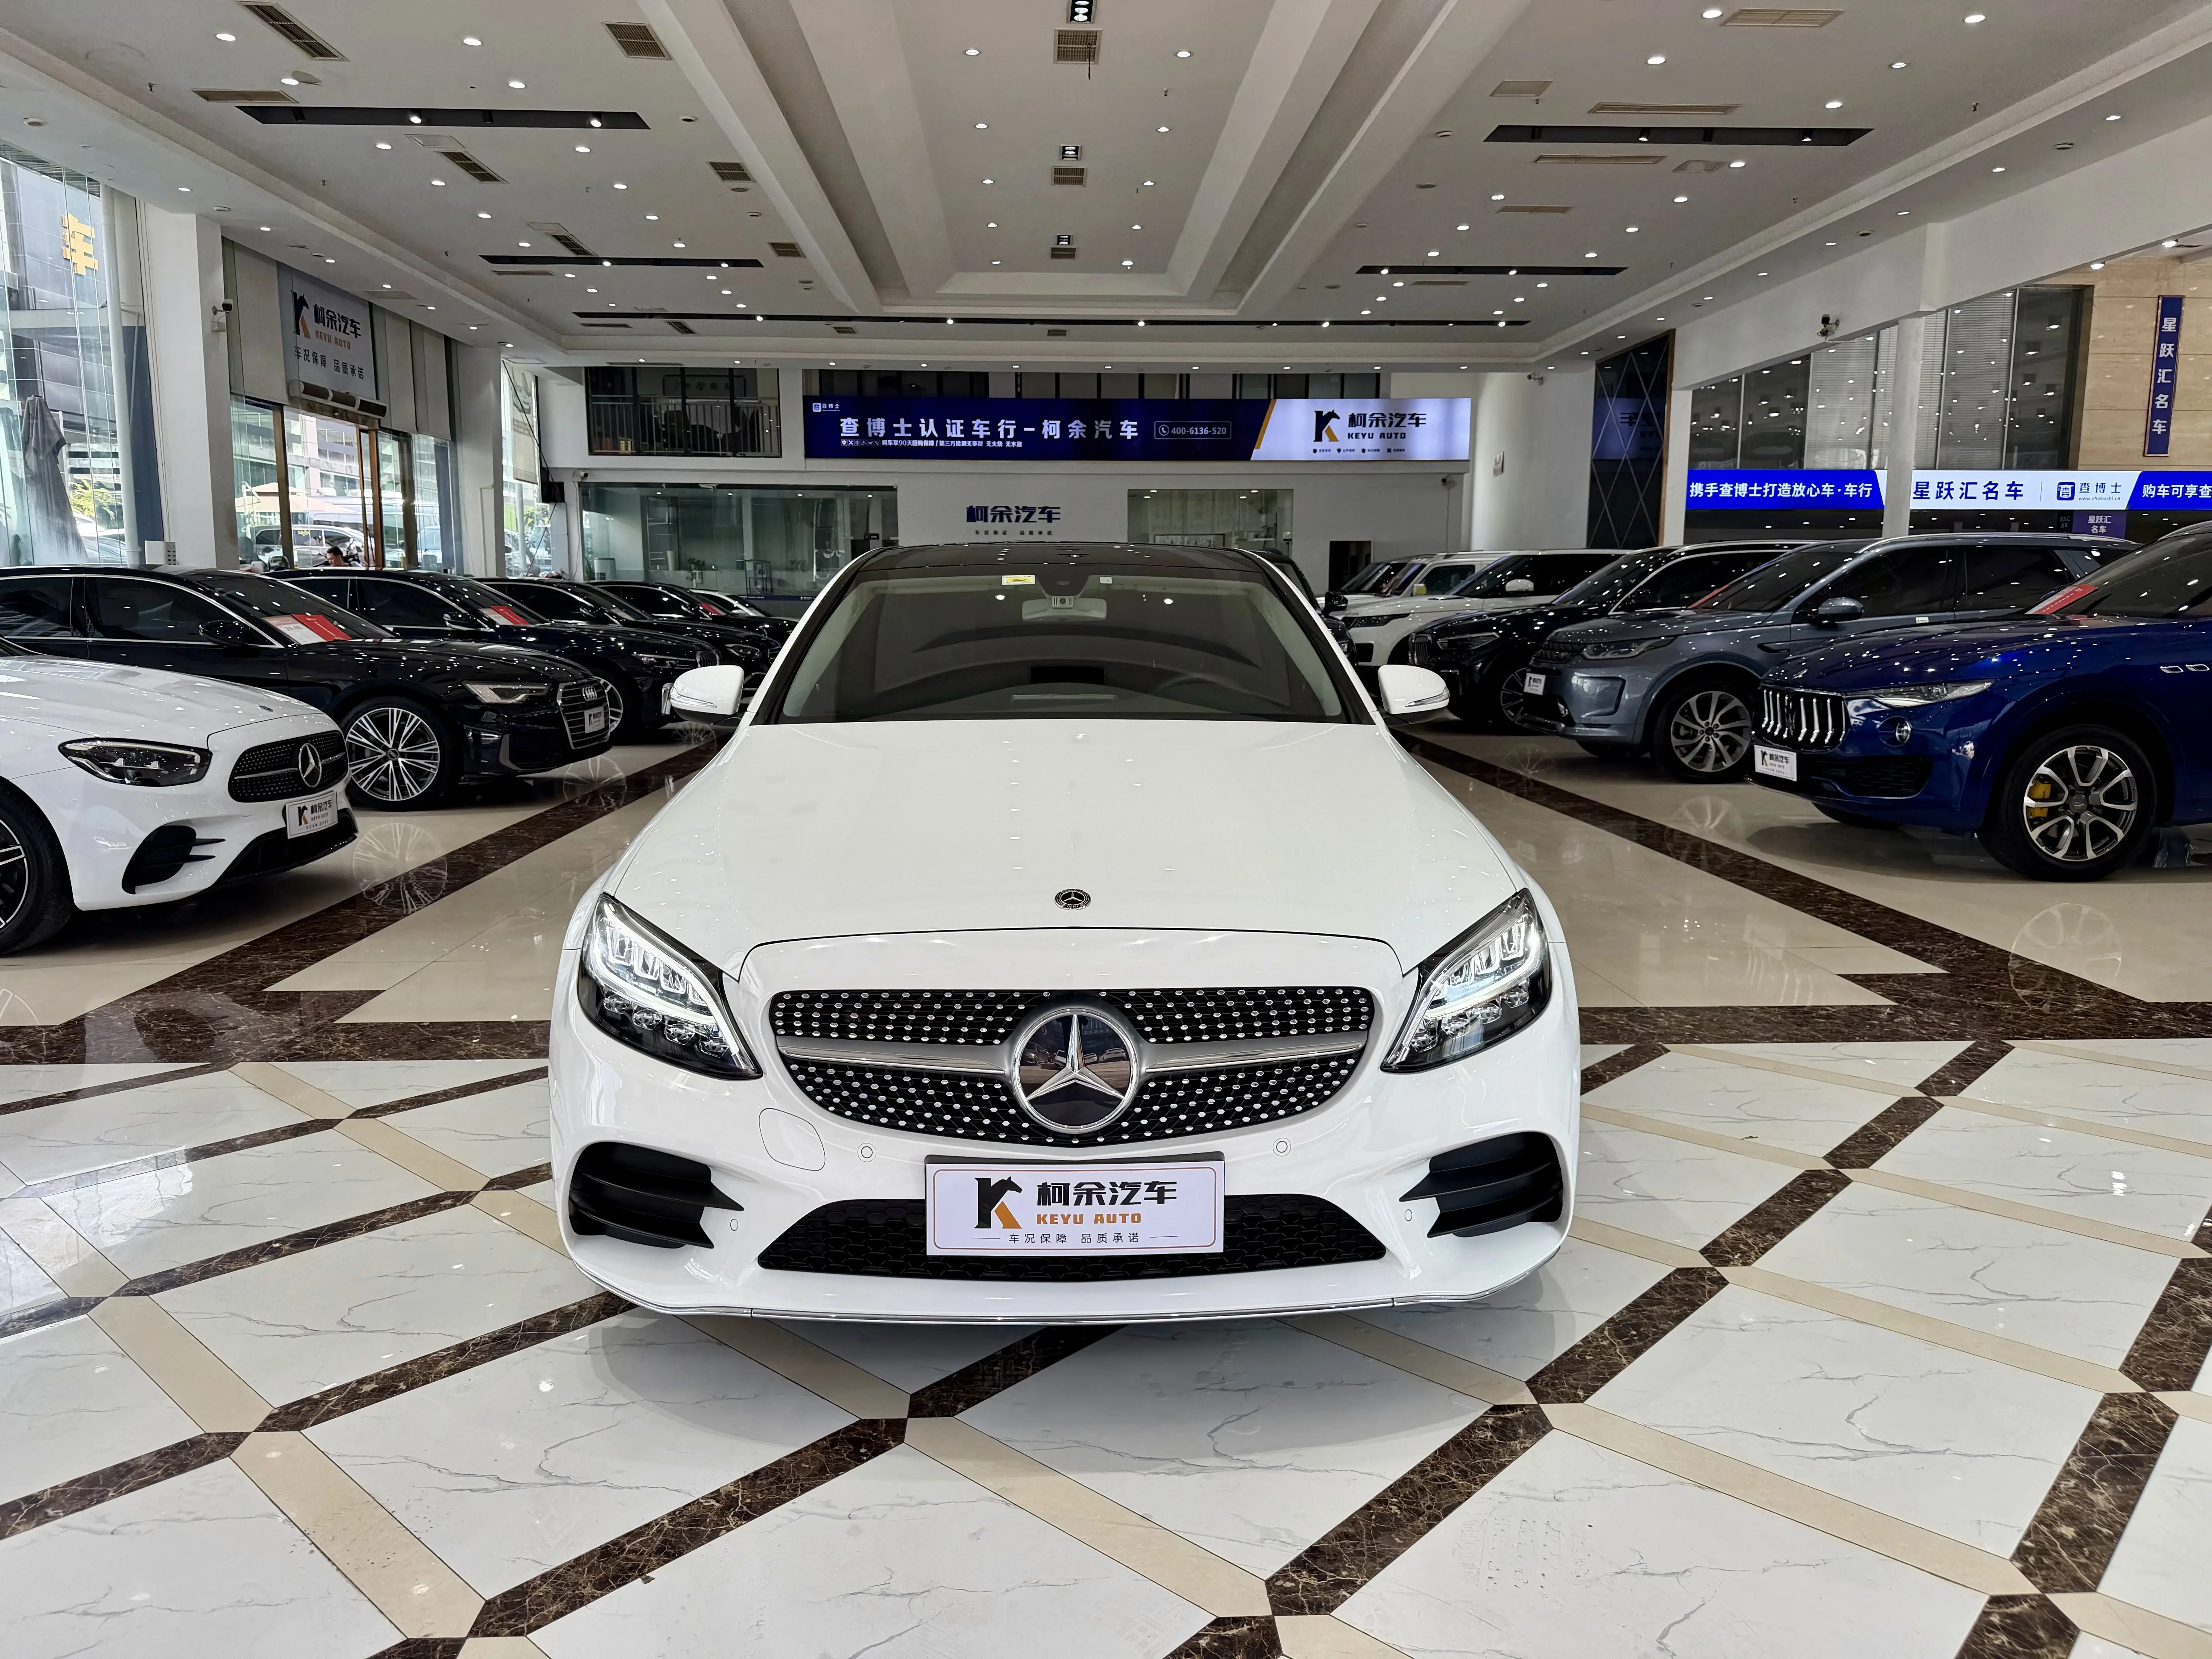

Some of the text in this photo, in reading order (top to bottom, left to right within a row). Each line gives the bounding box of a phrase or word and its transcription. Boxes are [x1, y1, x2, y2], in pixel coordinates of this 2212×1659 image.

[314, 304, 361, 338] 柯余汽车
[315, 330, 350, 350] KEYU AUTO
[295, 346, 364, 380] 车况保障 品质承诺
[2152, 317, 2177, 434] 星跃汇名车
[1348, 413, 1426, 428] 柯余汽车
[1913, 481, 2023, 500] 星跃汇名车
[2079, 482, 2121, 493] 查博士
[2142, 484, 2212, 498] 购车可享查
[966, 505, 1061, 523] 柯余汽车
[2088, 515, 2112, 524] 星跃汇
[2091, 525, 2107, 533] 名车
[1037, 1181, 1177, 1206] 柯余汽车
[1037, 1213, 1142, 1225] KEYU AUTO
[1009, 1232, 1140, 1244] 车况保障 品质承诺
